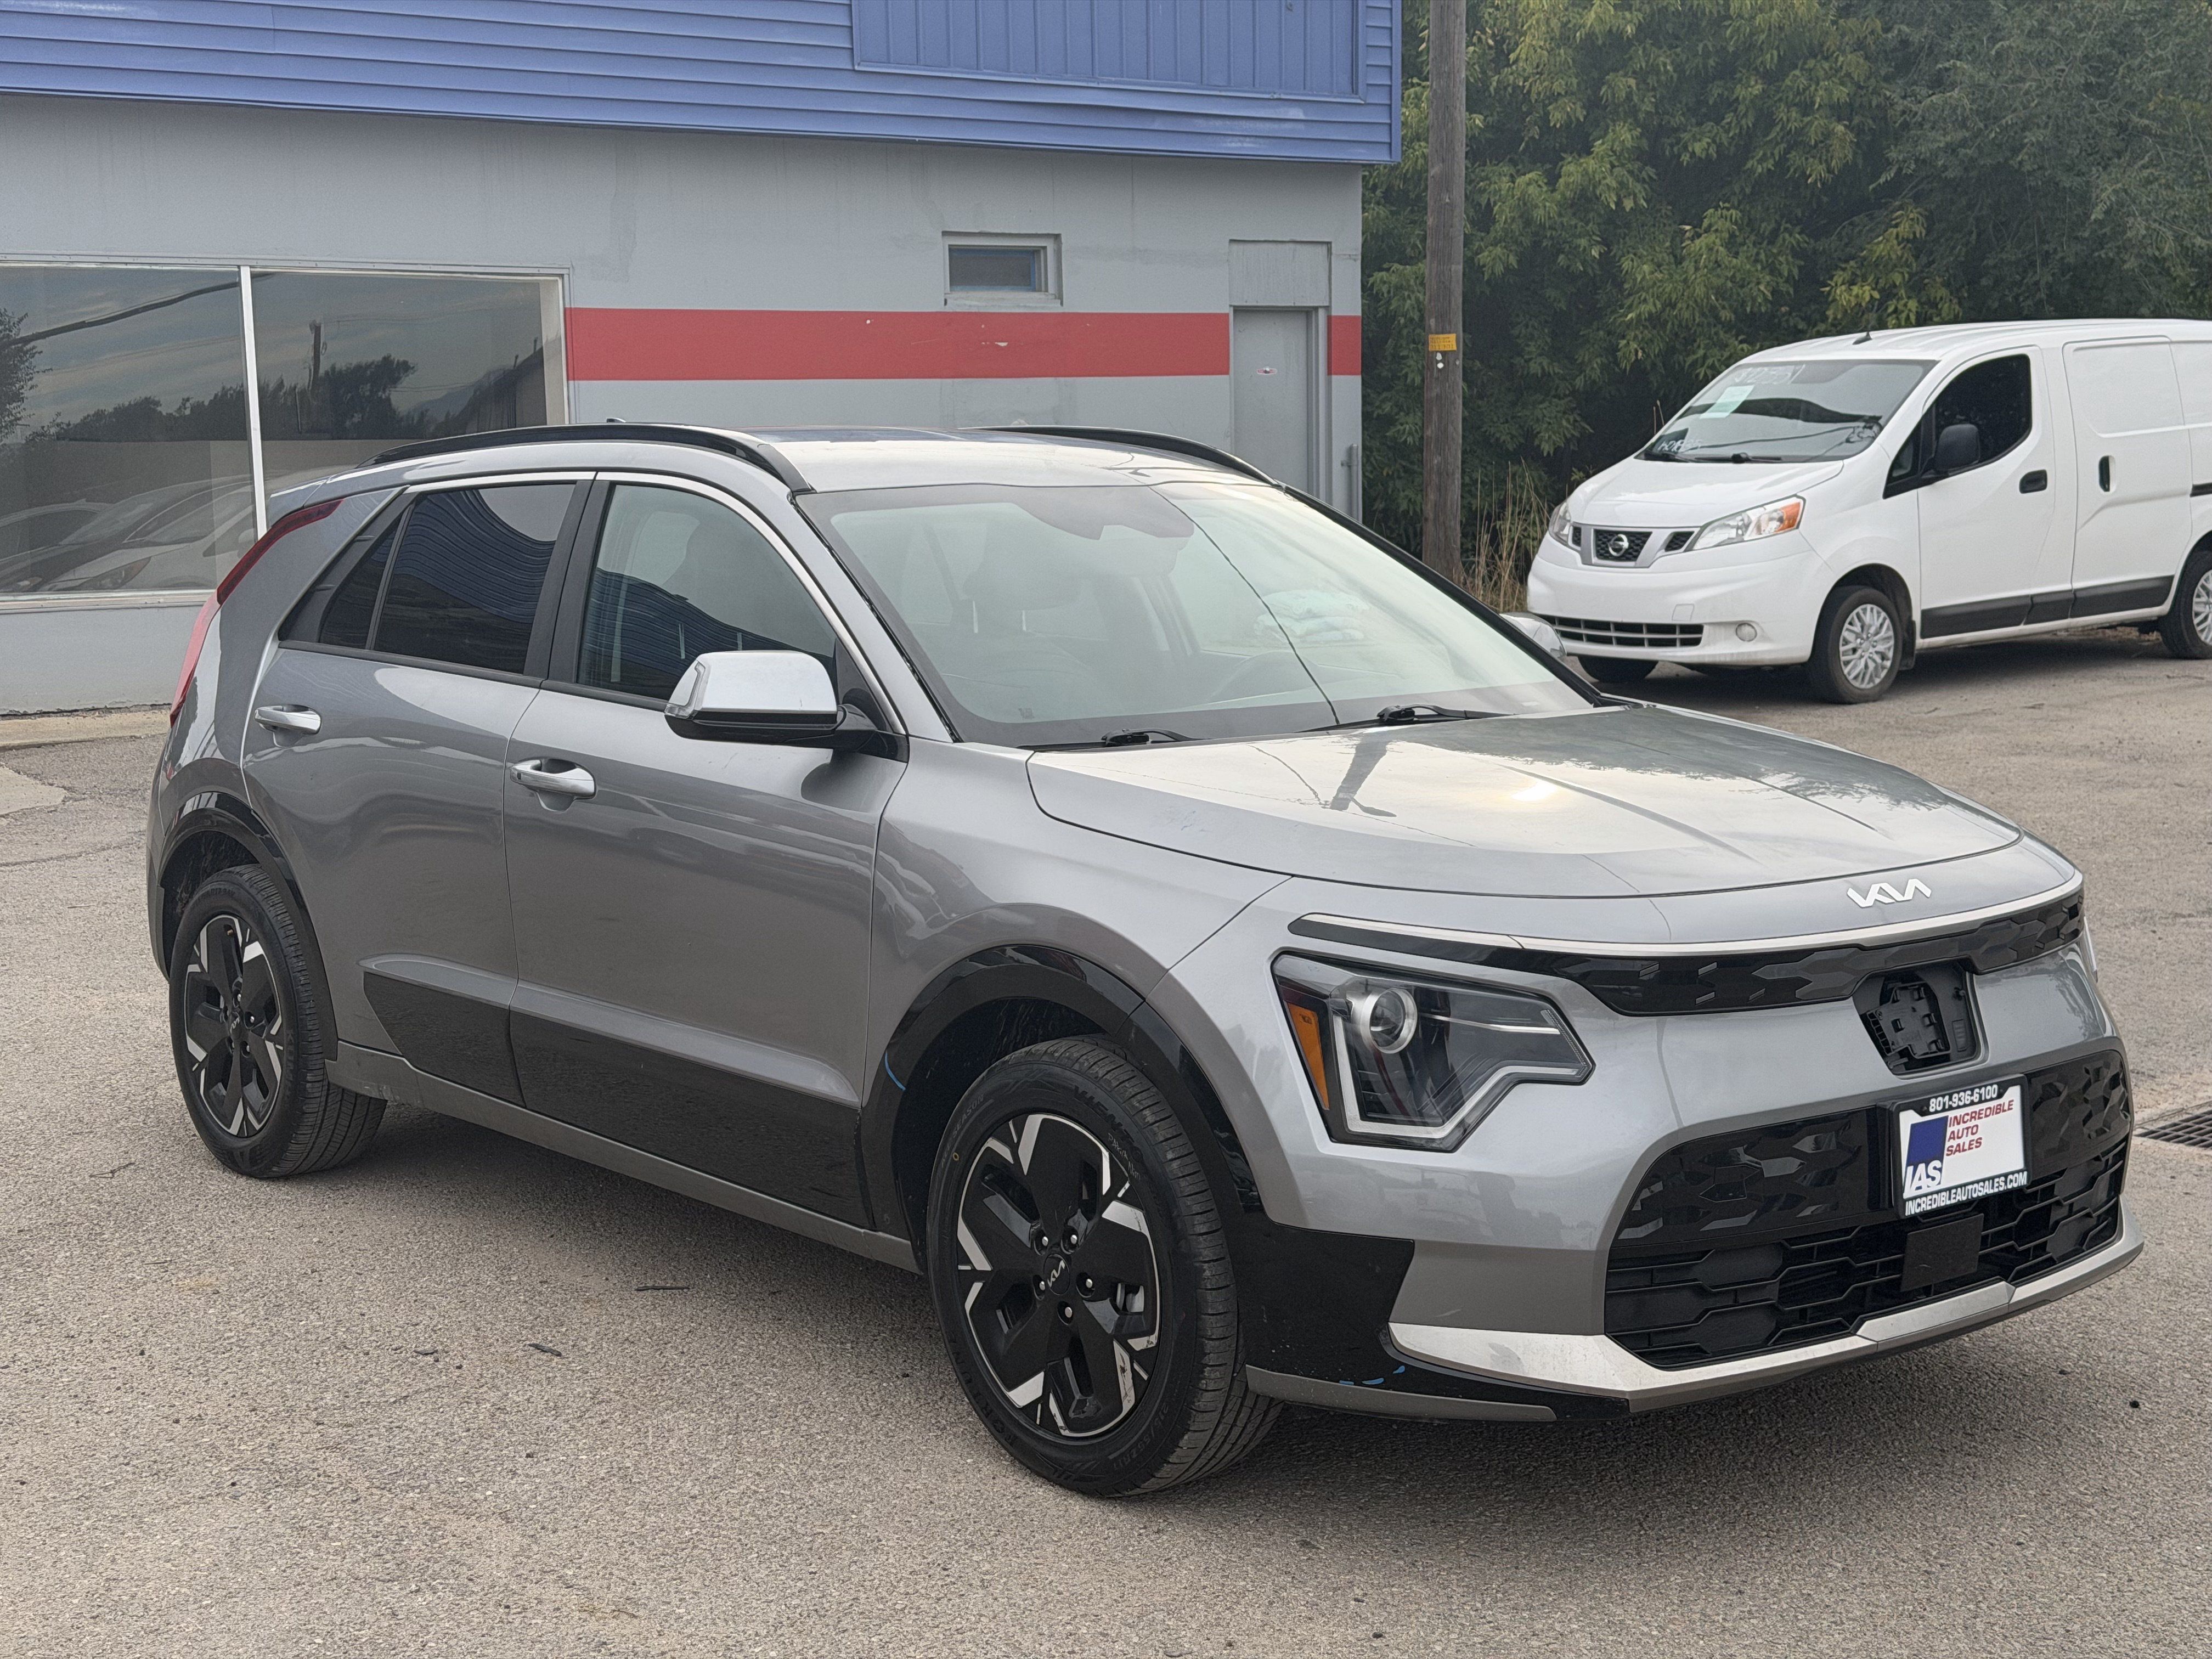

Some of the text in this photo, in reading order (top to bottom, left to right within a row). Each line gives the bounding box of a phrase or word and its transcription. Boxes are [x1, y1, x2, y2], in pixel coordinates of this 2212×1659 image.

[1847, 879, 1931, 909] KIA
[1929, 1085, 1997, 1113] 801-936-6100
[1949, 1099, 2014, 1127] INCREDIBLE
[953, 1094, 984, 1138] SEASON
[1946, 1137, 1982, 1156] SALES
[1948, 1125, 1979, 1142] AUTO
[1904, 1160, 1943, 1198] IAS
[1905, 1171, 2027, 1216] INCREDIBLEAUTOSALES.COM
